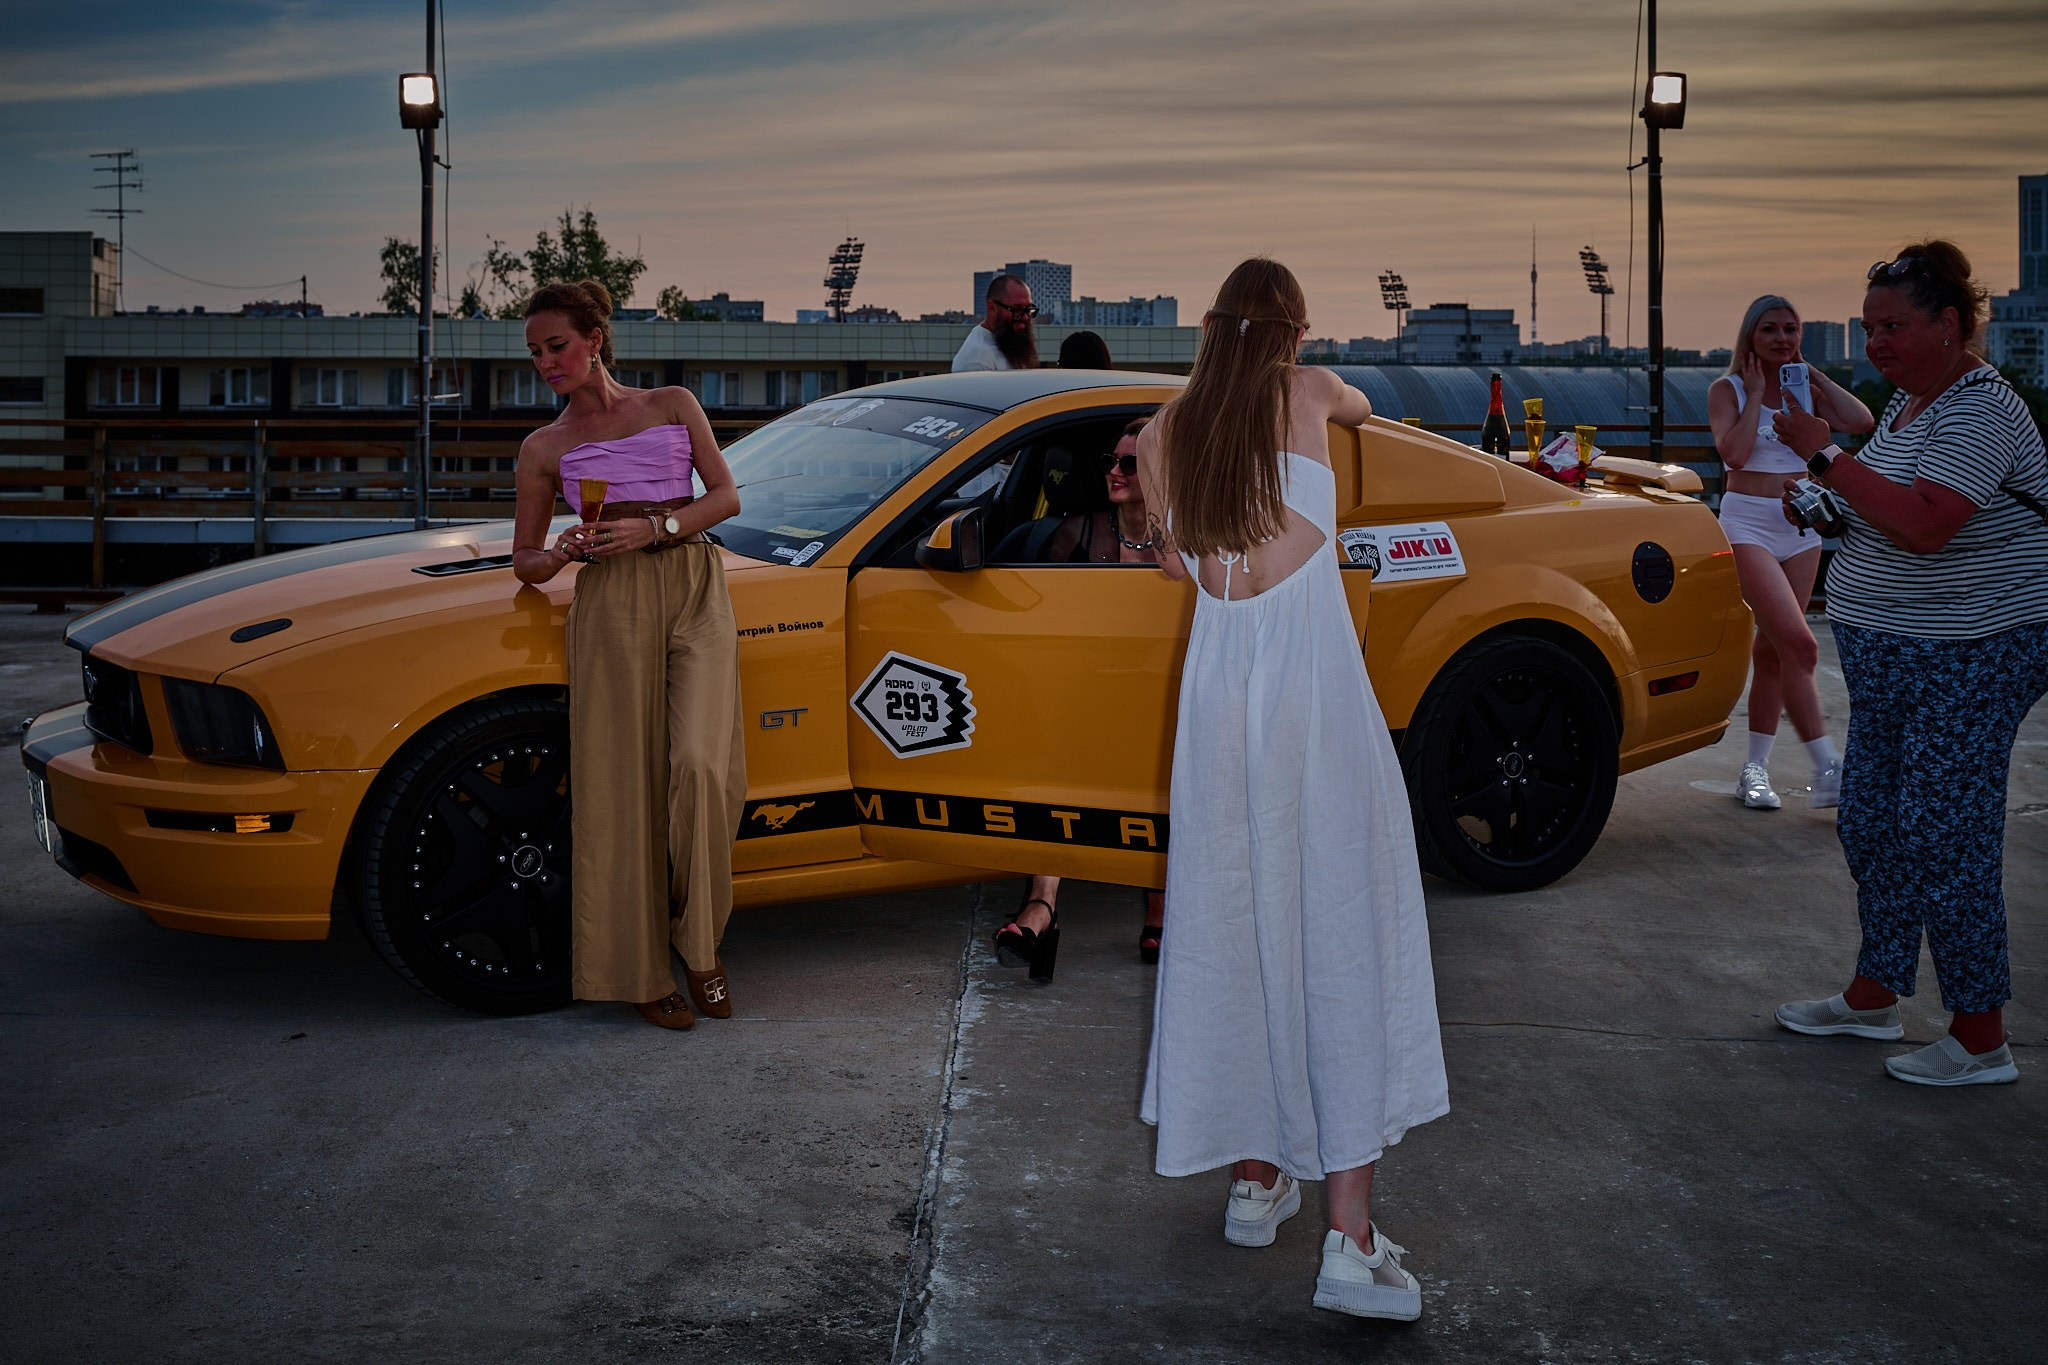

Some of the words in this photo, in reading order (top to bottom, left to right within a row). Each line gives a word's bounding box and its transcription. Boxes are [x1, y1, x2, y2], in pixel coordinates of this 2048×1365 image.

[902, 416, 959, 438] 293
[1389, 538, 1452, 559] JIKIU
[778, 621, 824, 633] Войнов
[886, 691, 939, 722] 293
[761, 708, 809, 729] GT
